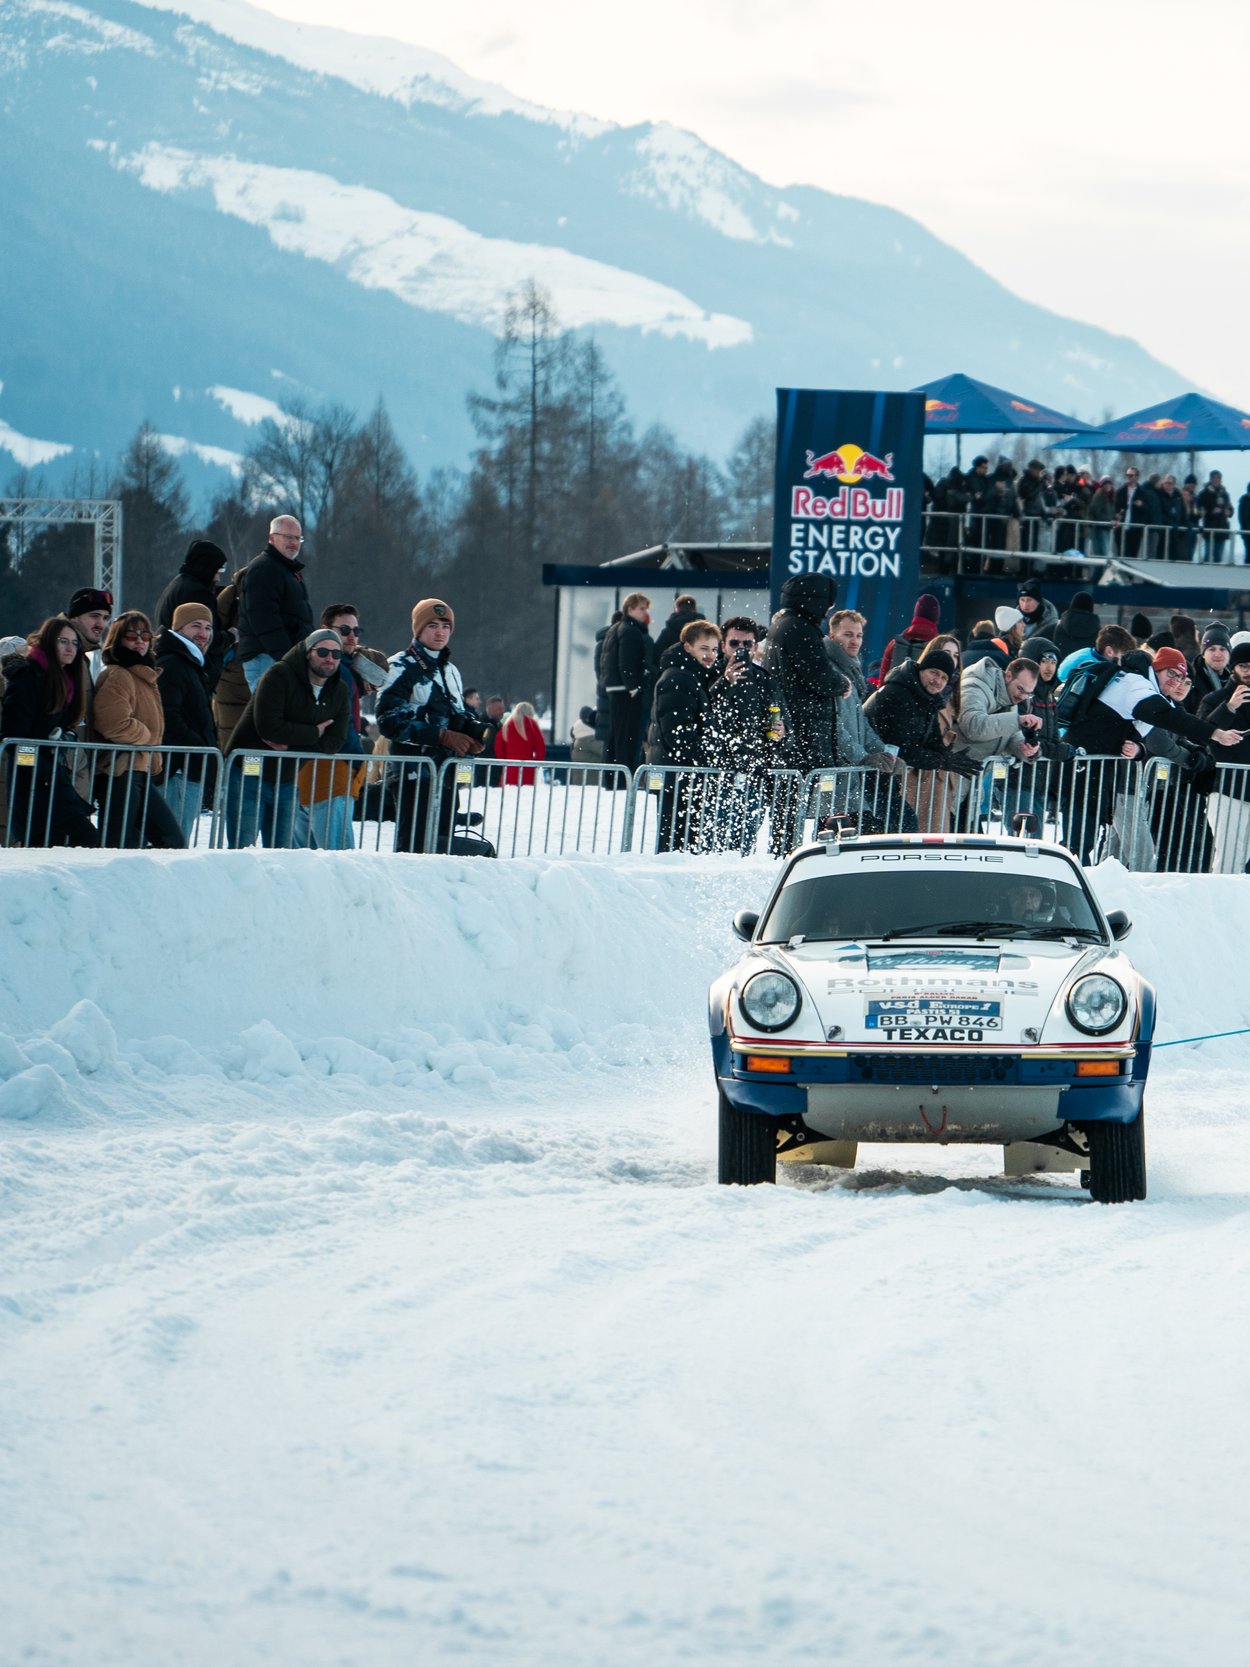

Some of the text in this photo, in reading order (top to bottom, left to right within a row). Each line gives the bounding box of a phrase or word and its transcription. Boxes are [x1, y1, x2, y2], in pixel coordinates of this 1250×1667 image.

[791, 485, 904, 521] Red Bull
[790, 523, 901, 551] ENERGY
[788, 549, 900, 577] STATION
[861, 854, 1004, 863] PORSCHE
[827, 977, 1039, 988] Rothmans
[880, 1000, 920, 1009] vsd
[880, 1015, 999, 1028] BB PW 846
[883, 1028, 984, 1042] TEXACO
